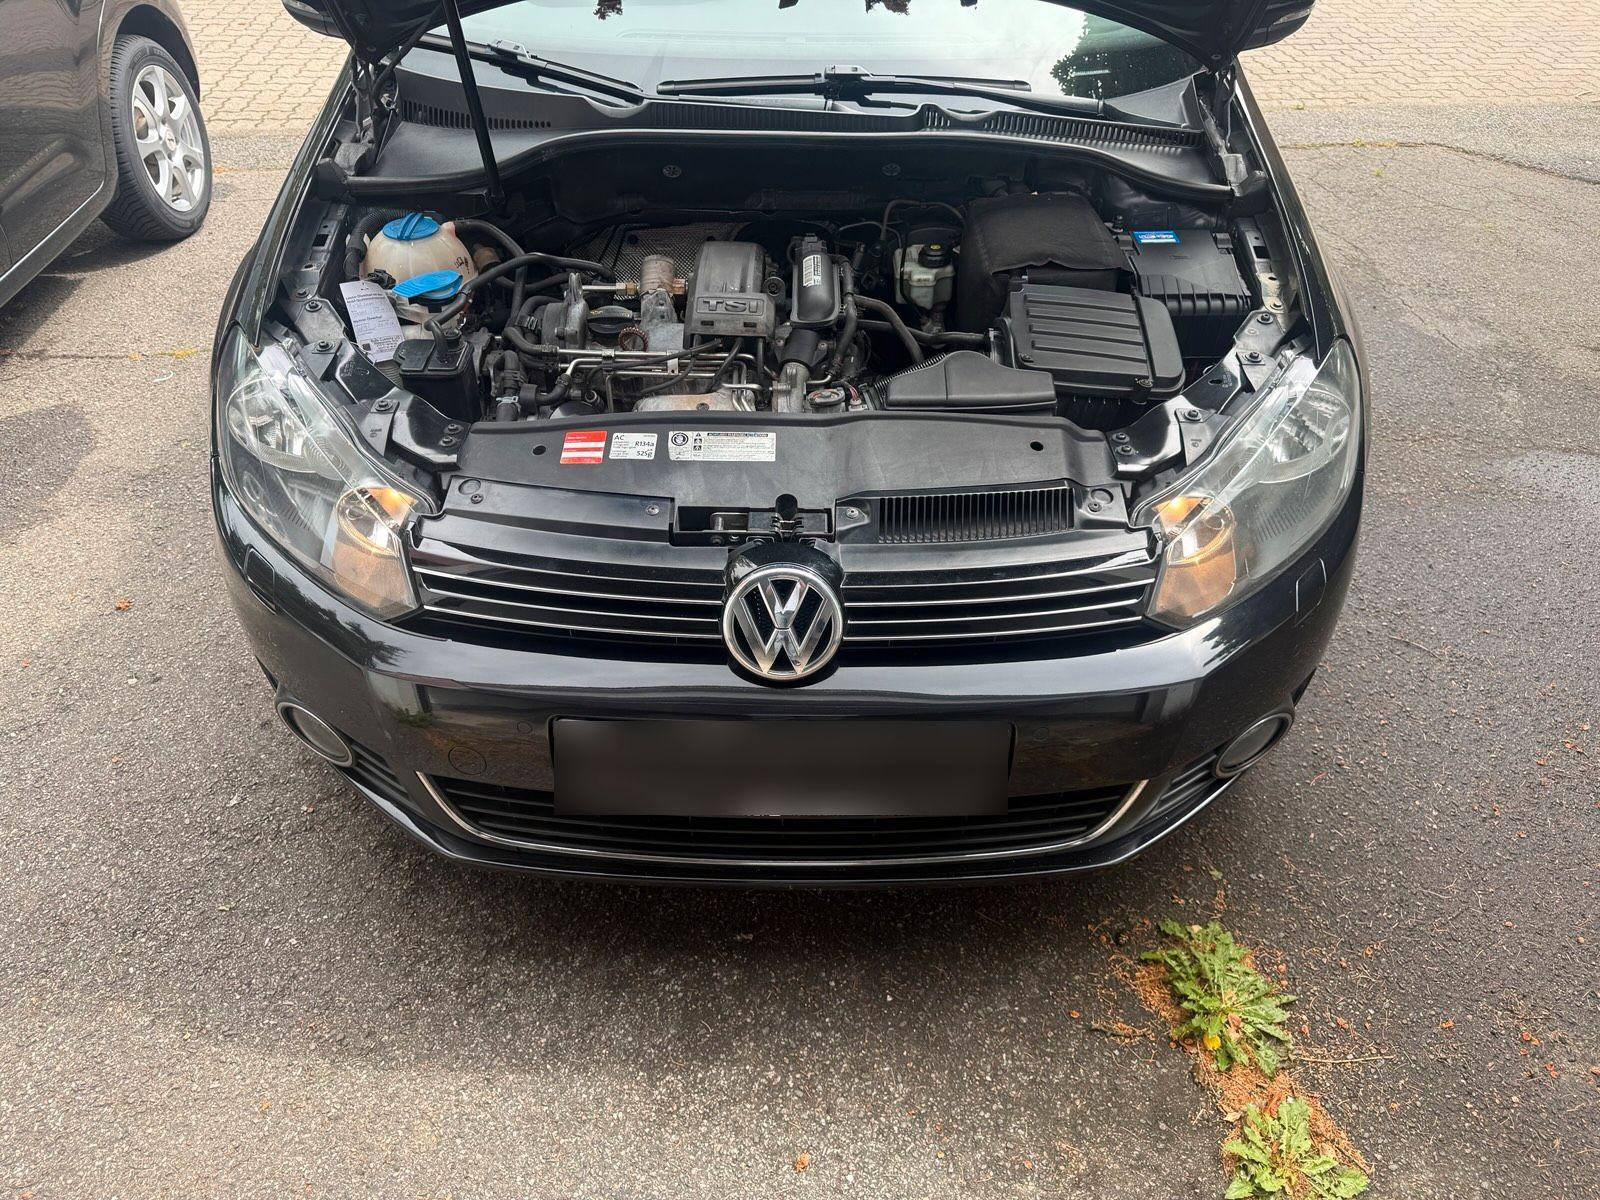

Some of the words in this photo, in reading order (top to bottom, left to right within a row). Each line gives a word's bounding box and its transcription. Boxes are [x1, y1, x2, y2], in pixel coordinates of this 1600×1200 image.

[702, 298, 759, 314] TSI
[636, 450, 653, 459] 525g
[726, 569, 841, 679] VW
